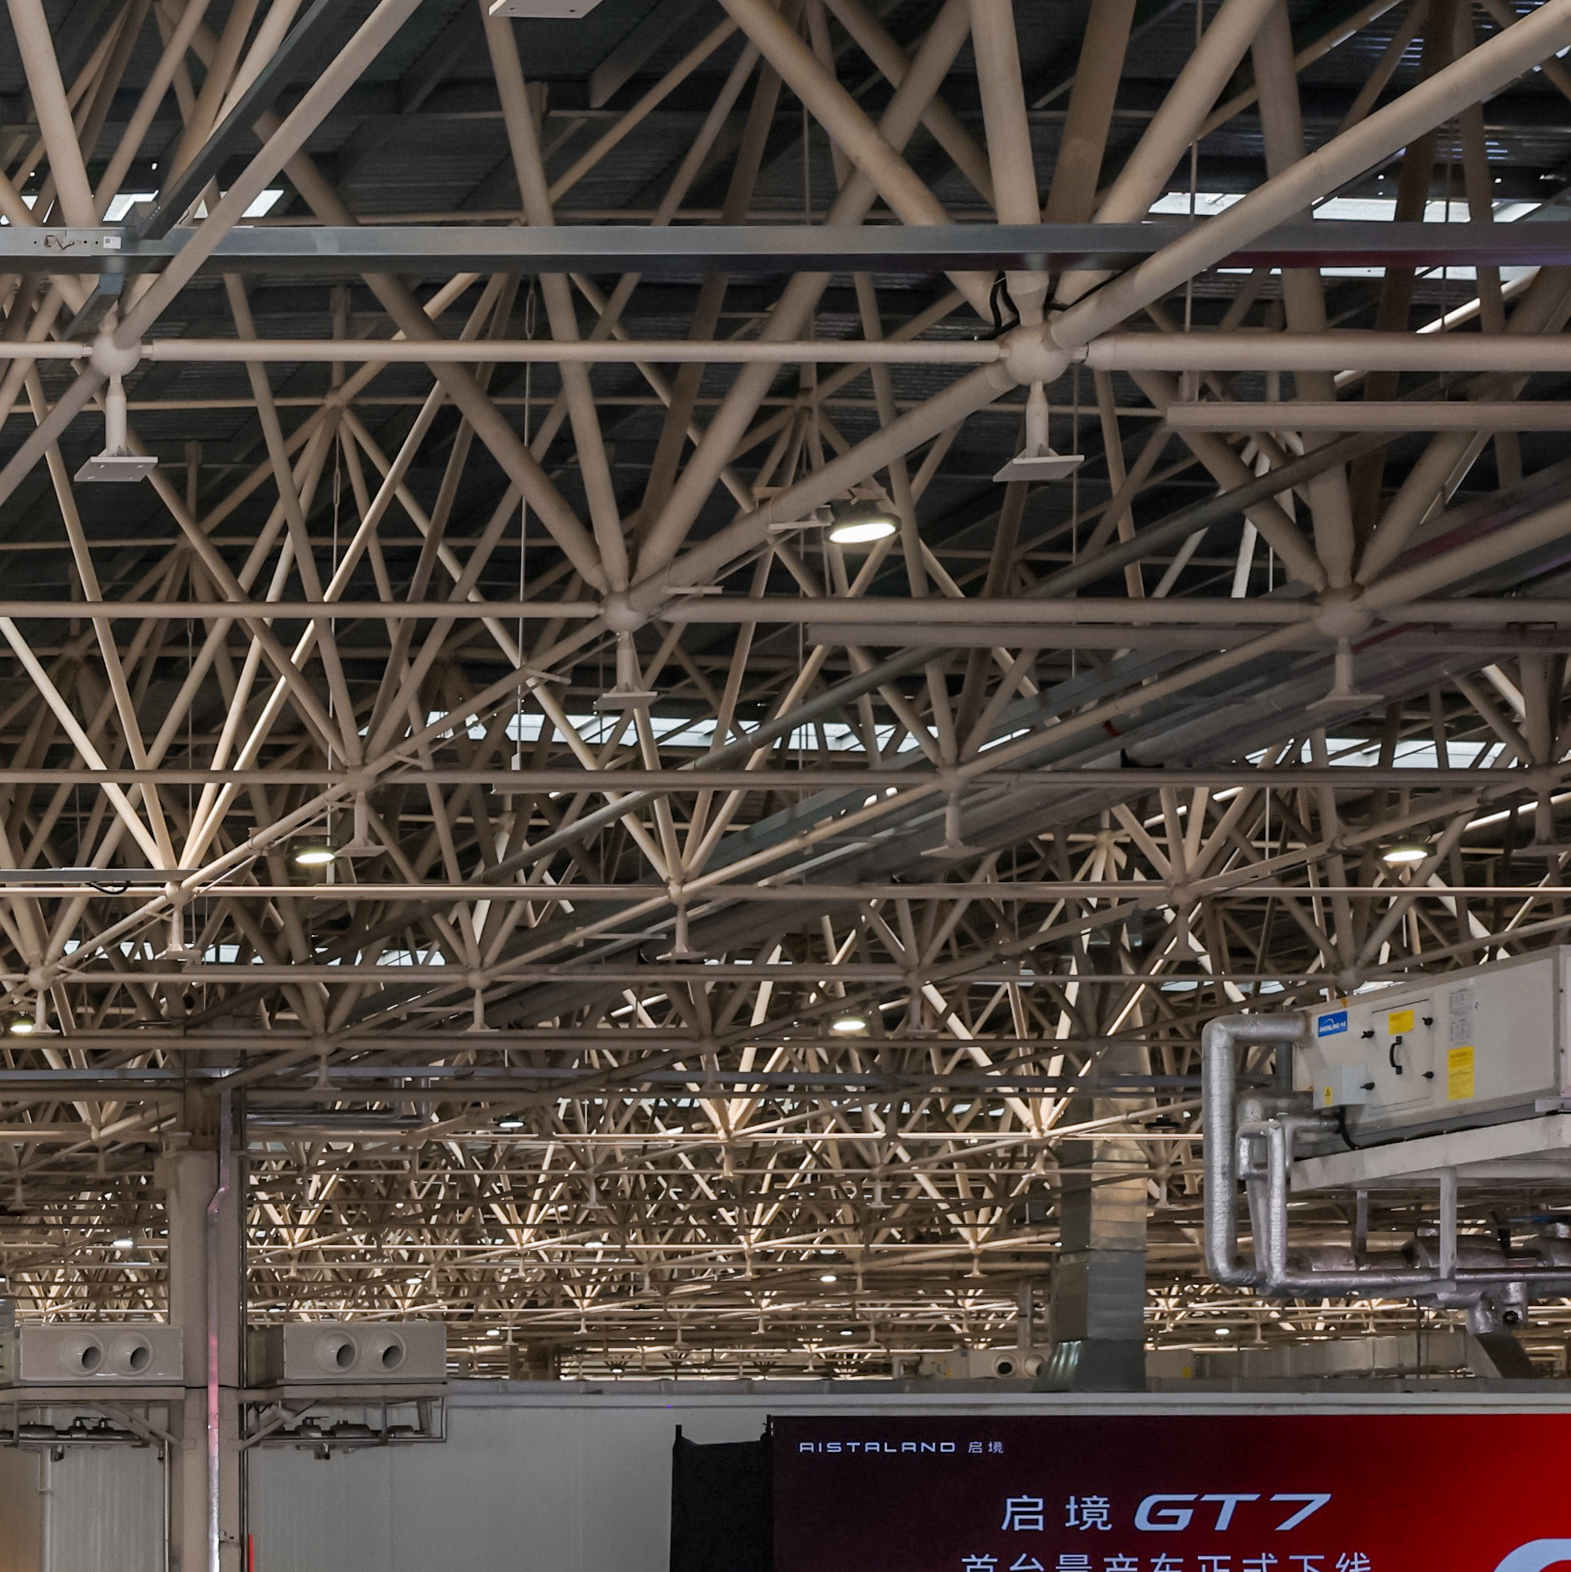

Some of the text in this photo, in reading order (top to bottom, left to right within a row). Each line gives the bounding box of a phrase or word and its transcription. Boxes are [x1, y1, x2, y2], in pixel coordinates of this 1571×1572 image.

[799, 1440, 1005, 1454] AISTALAND 启境
[1001, 1493, 1332, 1532] 启境 GT7
